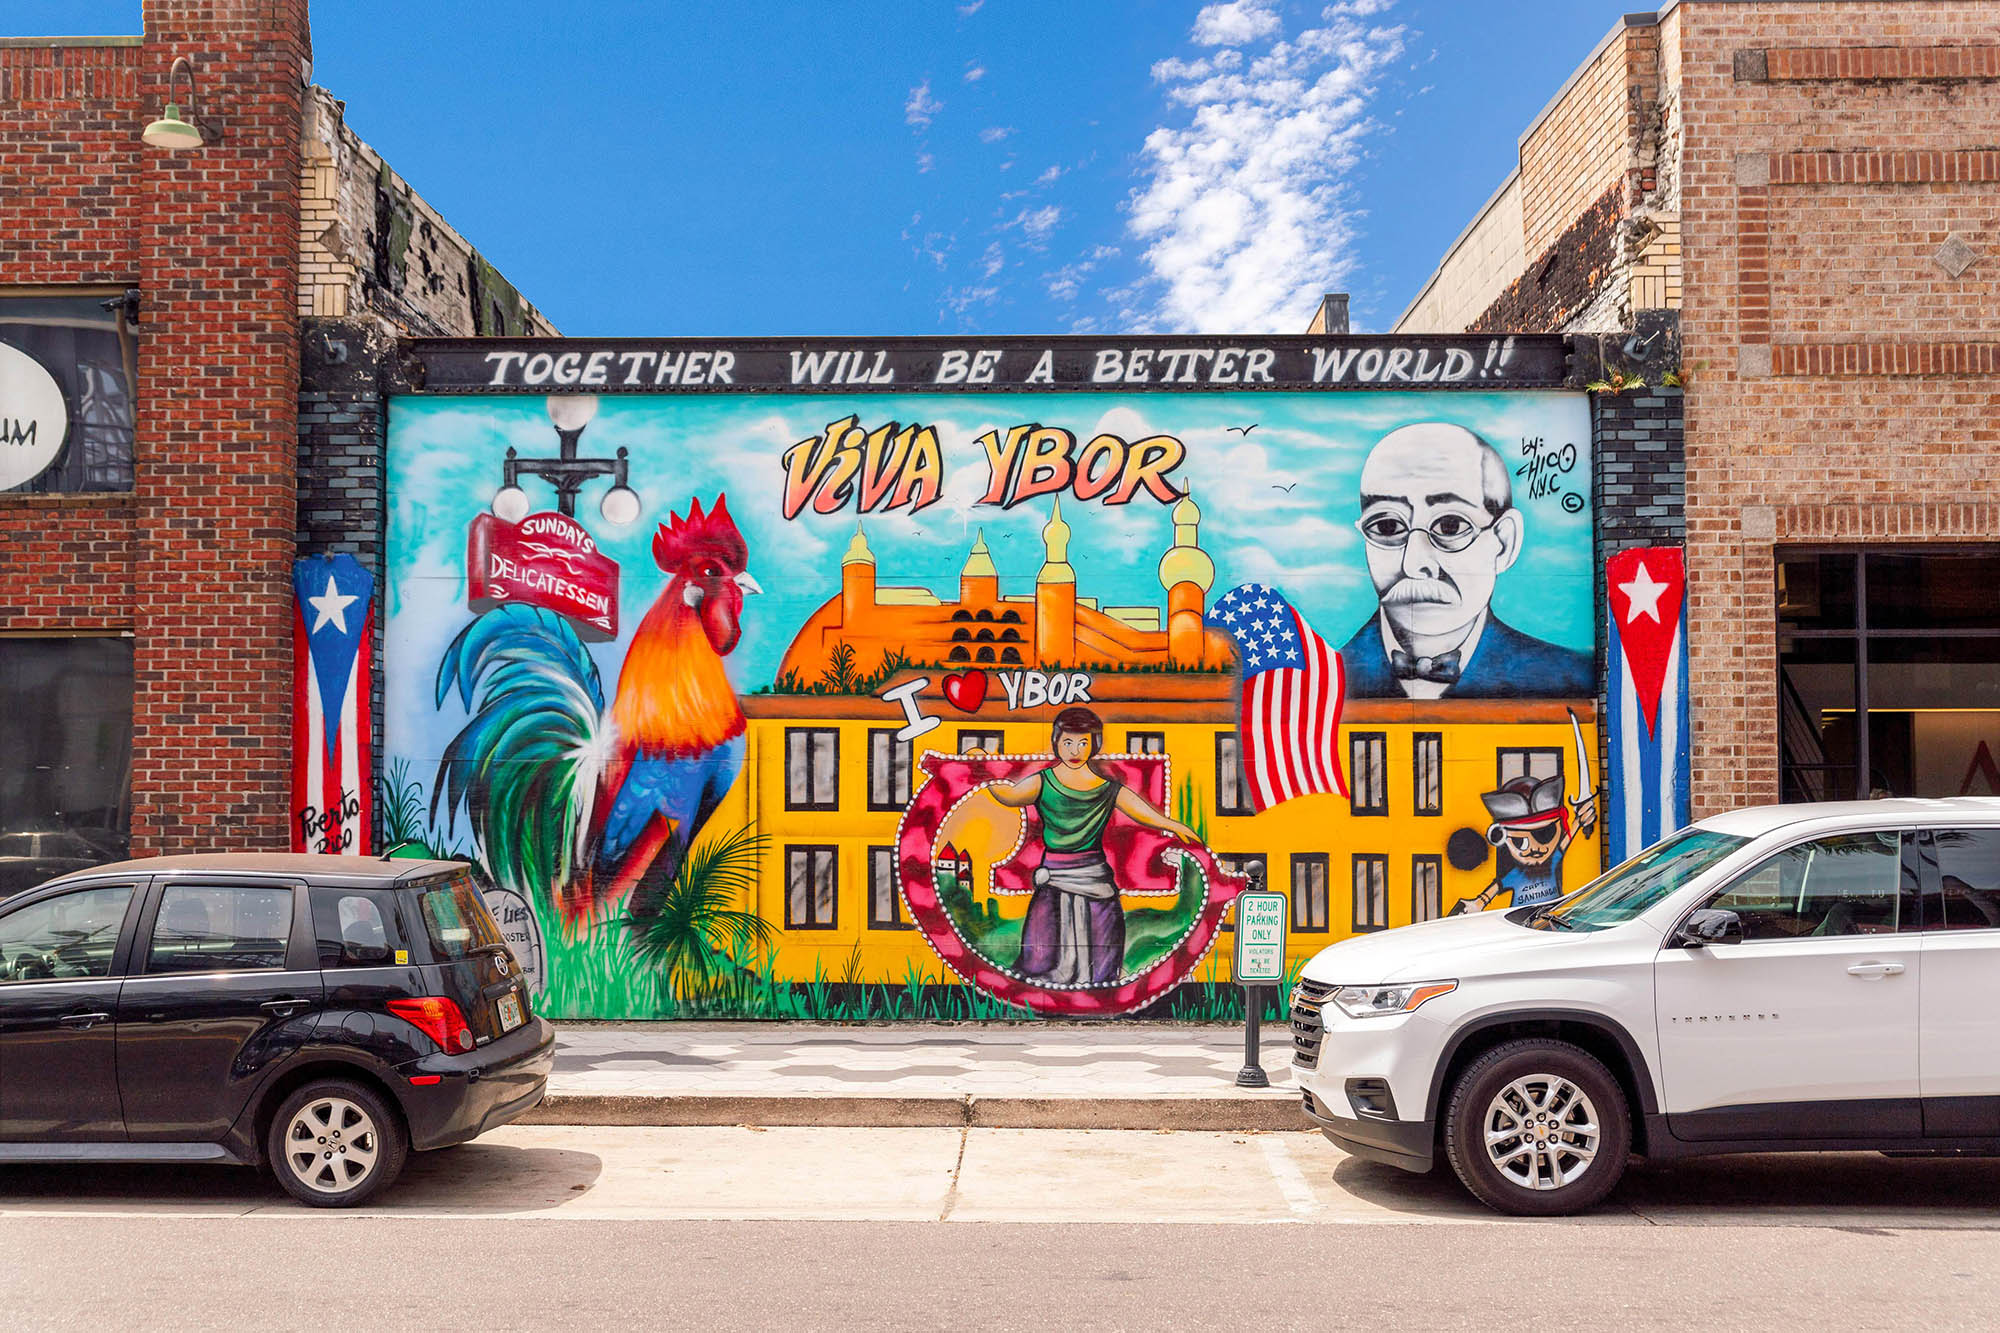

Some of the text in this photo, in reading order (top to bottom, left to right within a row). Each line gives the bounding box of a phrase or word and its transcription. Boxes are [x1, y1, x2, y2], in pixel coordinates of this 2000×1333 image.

[485, 350, 736, 386] TOGETHER
[789, 350, 894, 385] WILL
[935, 350, 1003, 384] BE
[1024, 349, 1056, 384] A
[1095, 348, 1276, 384] BETTER
[972, 422, 1190, 510] YBOR
[521, 517, 594, 555] SUNDAYS
[489, 552, 609, 615] DELICATESSEN
[881, 669, 1092, 743] I YBOR
[313, 827, 353, 855] Rico
[1246, 914, 1279, 926] PARKING
[1247, 900, 1279, 912] 2 HOUR
[1251, 929, 1272, 940] ONLY
